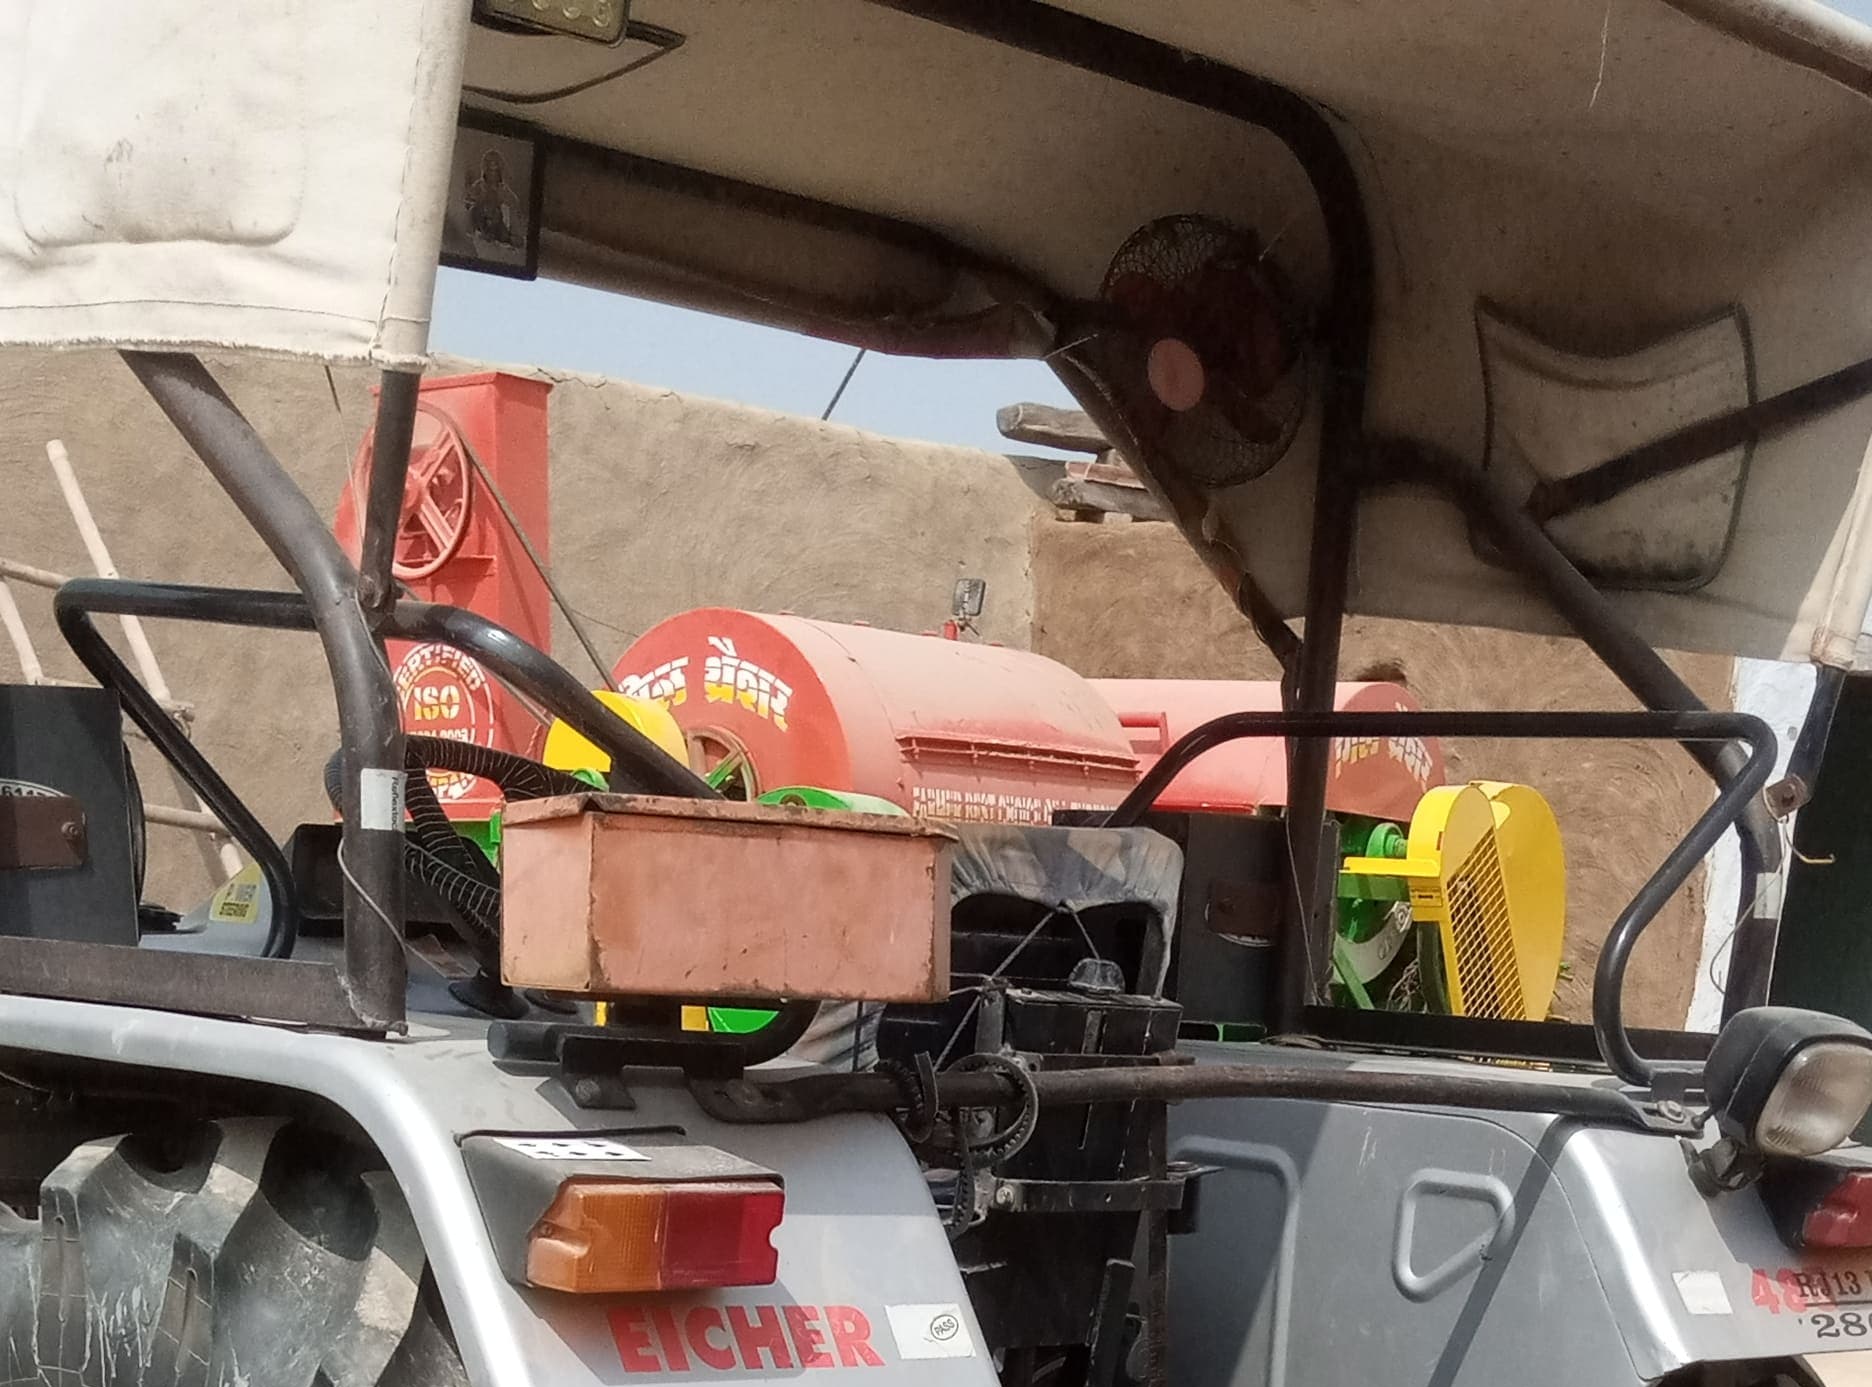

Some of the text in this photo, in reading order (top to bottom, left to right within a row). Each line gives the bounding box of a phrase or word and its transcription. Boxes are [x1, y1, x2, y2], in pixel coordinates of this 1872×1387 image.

[396, 643, 482, 698] ERTIFIED
[413, 685, 461, 721] ISO
[606, 1305, 886, 1373] EICHER
[934, 1318, 956, 1337] PASS
[1810, 1312, 1872, 1339] 28
